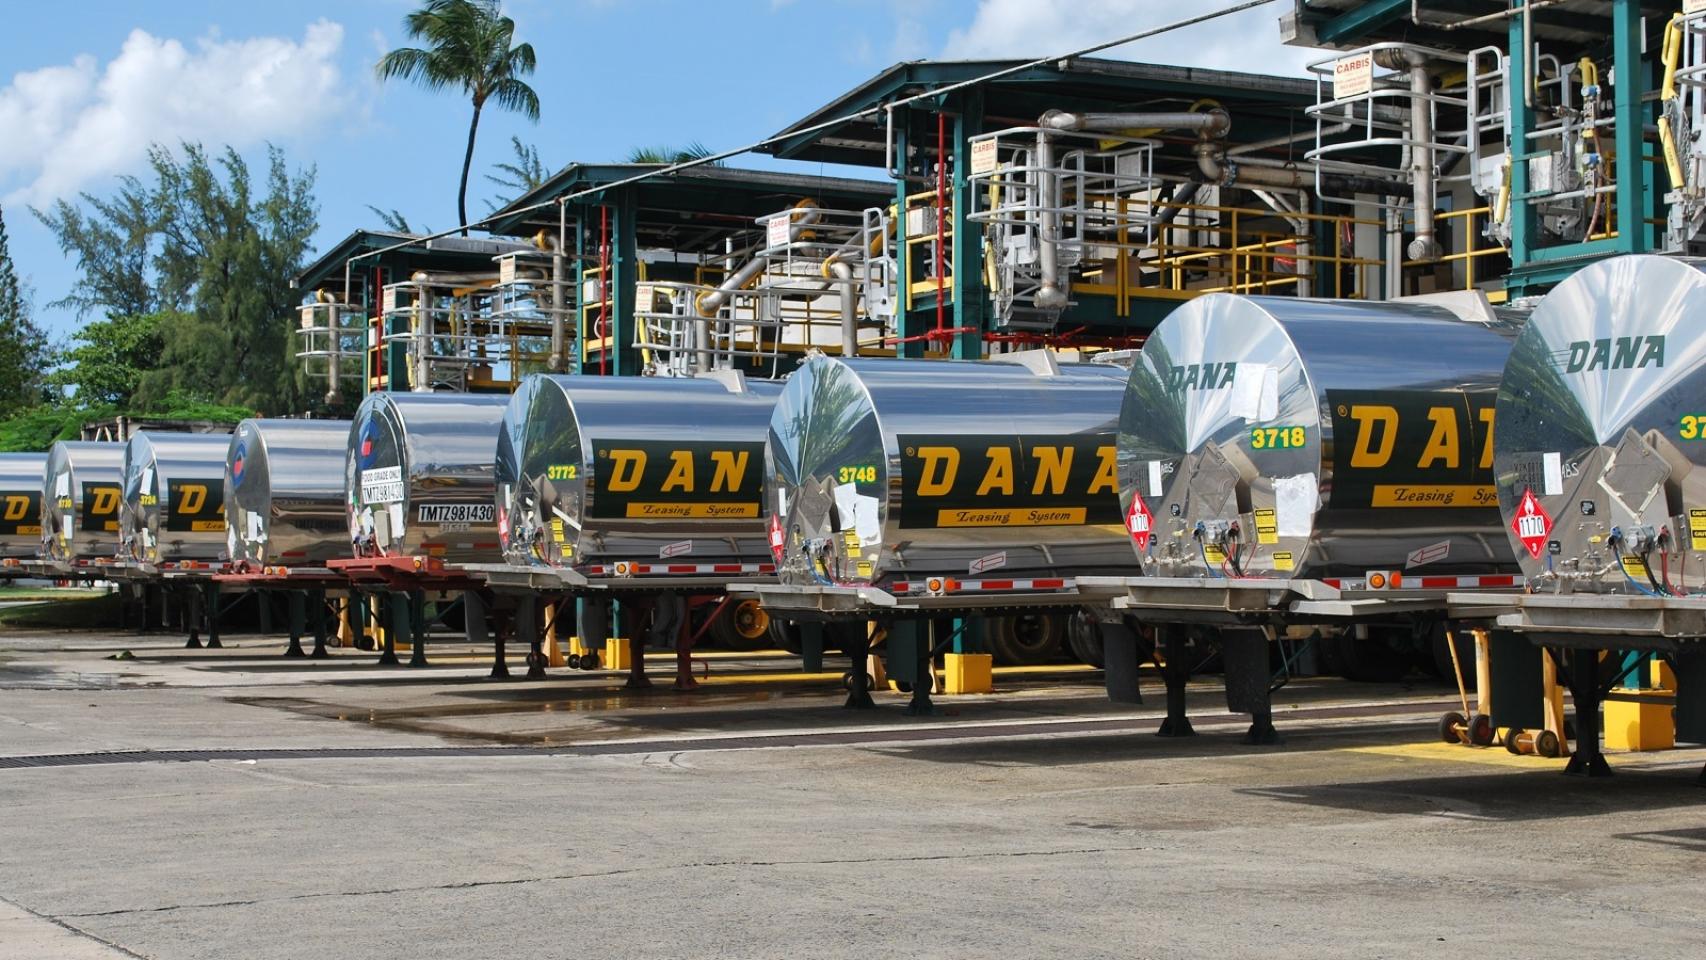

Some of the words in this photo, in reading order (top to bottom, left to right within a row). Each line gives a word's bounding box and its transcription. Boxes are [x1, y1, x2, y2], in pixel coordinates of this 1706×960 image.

[1336, 57, 1370, 74] CARBIS
[1566, 335, 1665, 374] DANA
[1168, 362, 1237, 393] DANA
[1252, 427, 1305, 449] 3718
[548, 465, 577, 480] 3772
[608, 449, 763, 492] DAN
[839, 466, 876, 482] 3748
[916, 446, 1119, 496] DANA
[1394, 488, 1455, 504] Leasing
[420, 505, 495, 521] TMTZ981430
[643, 504, 693, 516] Leasing
[706, 504, 746, 516] System
[956, 511, 1010, 525] Leasing
[1028, 510, 1072, 524] System
[1131, 514, 1149, 530] 1170
[1520, 516, 1544, 535] 1170
[1531, 542, 1538, 553] 3
